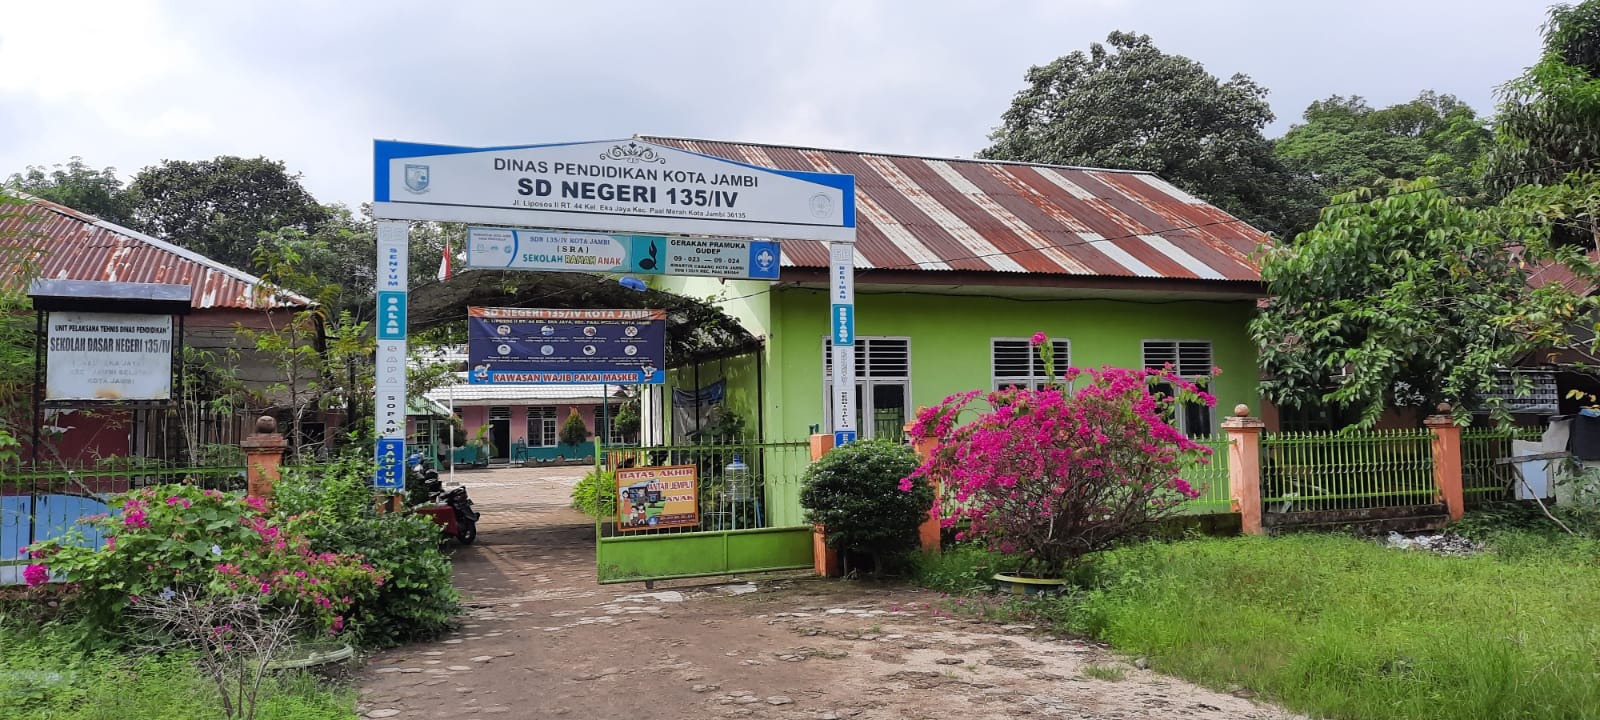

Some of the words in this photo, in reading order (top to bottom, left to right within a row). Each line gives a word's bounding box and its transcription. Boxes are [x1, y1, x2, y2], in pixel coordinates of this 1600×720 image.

[494, 158, 549, 174] DINAS
[554, 162, 658, 181] PENDIDIKAN
[663, 170, 707, 185] KOTA
[710, 174, 758, 188] JAMBI
[517, 178, 552, 197] SD
[561, 181, 656, 203] NEGERI
[666, 187, 738, 208] 135/IV
[523, 200, 553, 208] Liposos
[600, 204, 613, 212] Eka
[615, 205, 631, 214] Jaya
[688, 209, 704, 217] Kota
[589, 238, 610, 246] JAMBI
[670, 240, 708, 248] GERAKAN
[709, 240, 746, 249] PRAMUKA
[695, 247, 721, 255] GUDEP
[522, 253, 563, 263] SEKOLAH
[564, 254, 597, 265] RAMAH
[597, 256, 621, 265] ANAK
[387, 247, 399, 287] SENYUM
[386, 296, 400, 335] SALAM
[483, 308, 498, 317] SD
[502, 308, 543, 318] NEGERI
[548, 309, 582, 319] 135/IV
[585, 309, 615, 318] KOTA
[54, 324, 68, 332] UNIT
[68, 324, 100, 332] PELAKSANA
[136, 326, 167, 334] PENDIDIKAN
[50, 337, 86, 352] SEKOLAH
[87, 338, 114, 353] DASAR
[115, 338, 143, 353] NEGERI
[144, 339, 170, 354] 135/IV
[493, 373, 541, 383] KAWASAN
[542, 373, 572, 382] WAJIB
[573, 373, 601, 382] PAKAI
[602, 373, 639, 382] MASKER
[386, 395, 397, 433] SOPAN
[385, 443, 396, 484] SANTUN
[620, 471, 655, 479] BATAS
[659, 468, 694, 477] AKHIR
[670, 480, 693, 490] JEMPUT
